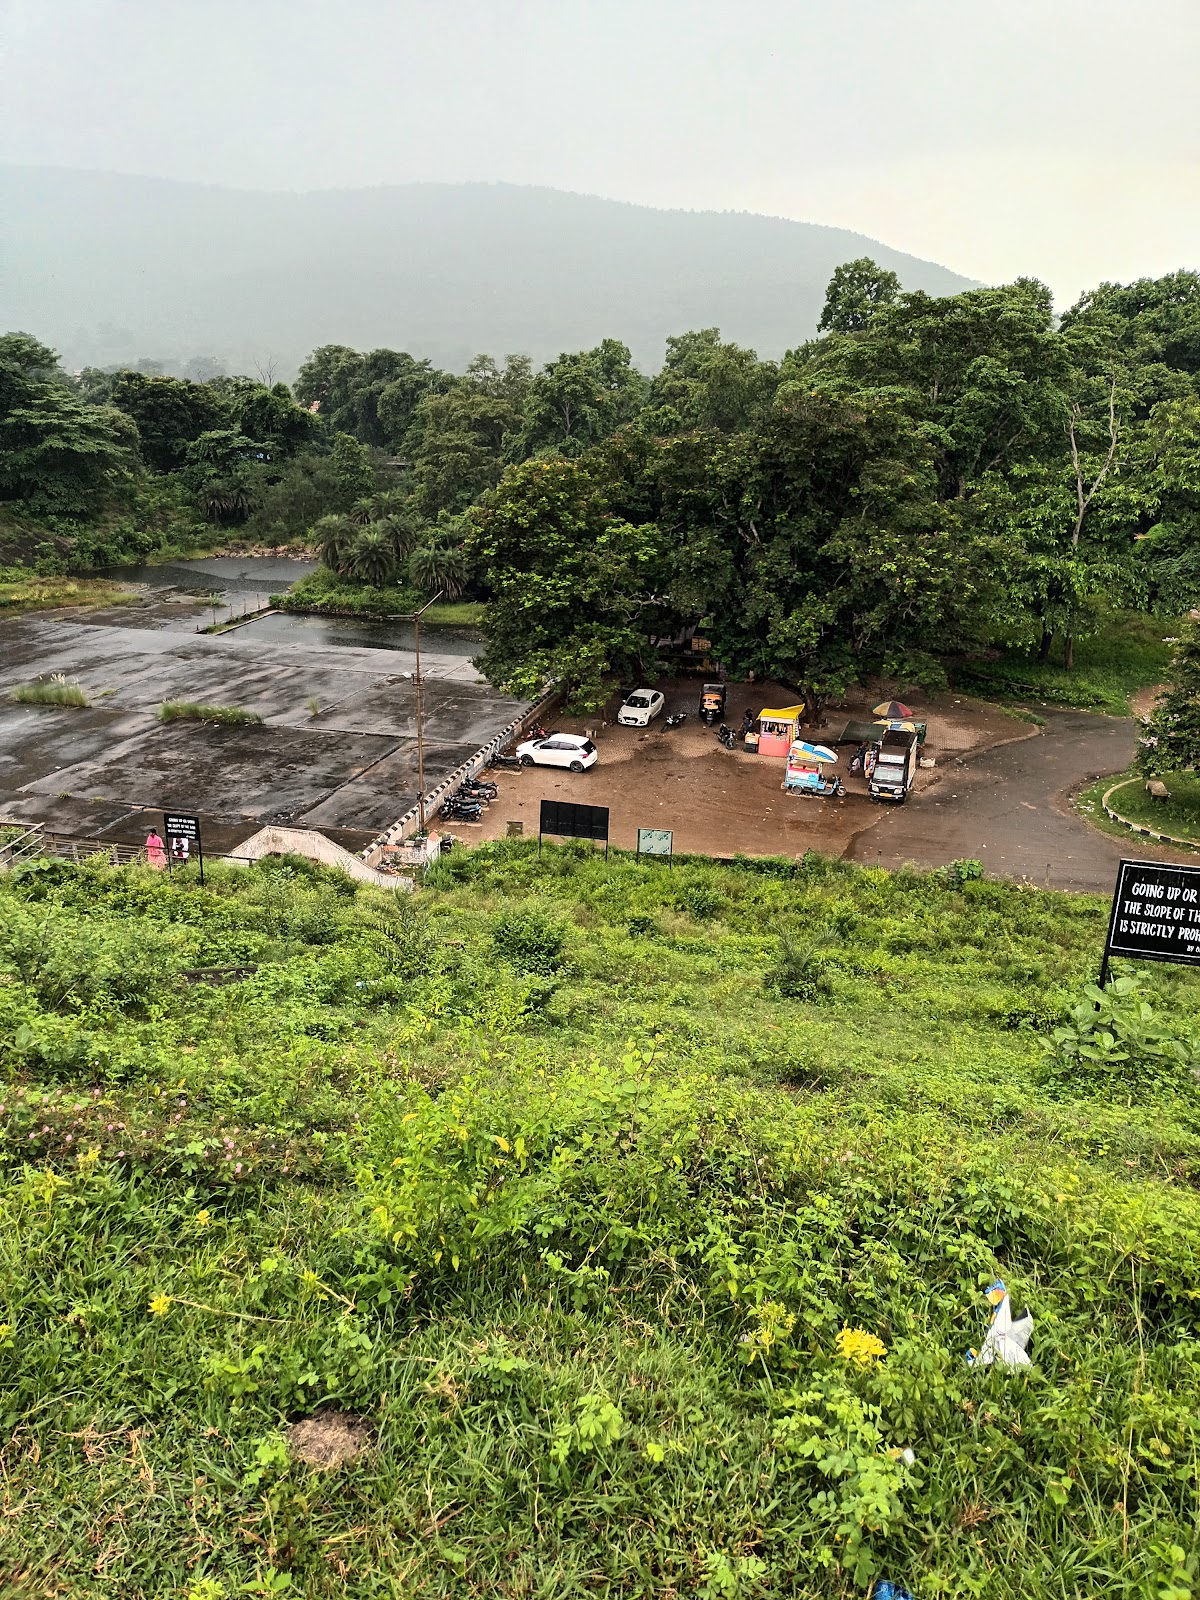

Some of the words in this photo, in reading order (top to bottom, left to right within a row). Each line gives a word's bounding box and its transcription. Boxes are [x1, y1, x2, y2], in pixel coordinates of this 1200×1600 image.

[1131, 882, 1165, 899] GOING
[1166, 886, 1181, 901] UP
[1182, 888, 1198, 904] OR
[1124, 900, 1142, 916] THE
[1143, 903, 1172, 920] SLOPE
[1173, 907, 1186, 921] OF
[1119, 919, 1129, 933] IS
[1129, 920, 1175, 939] STRICTLY
